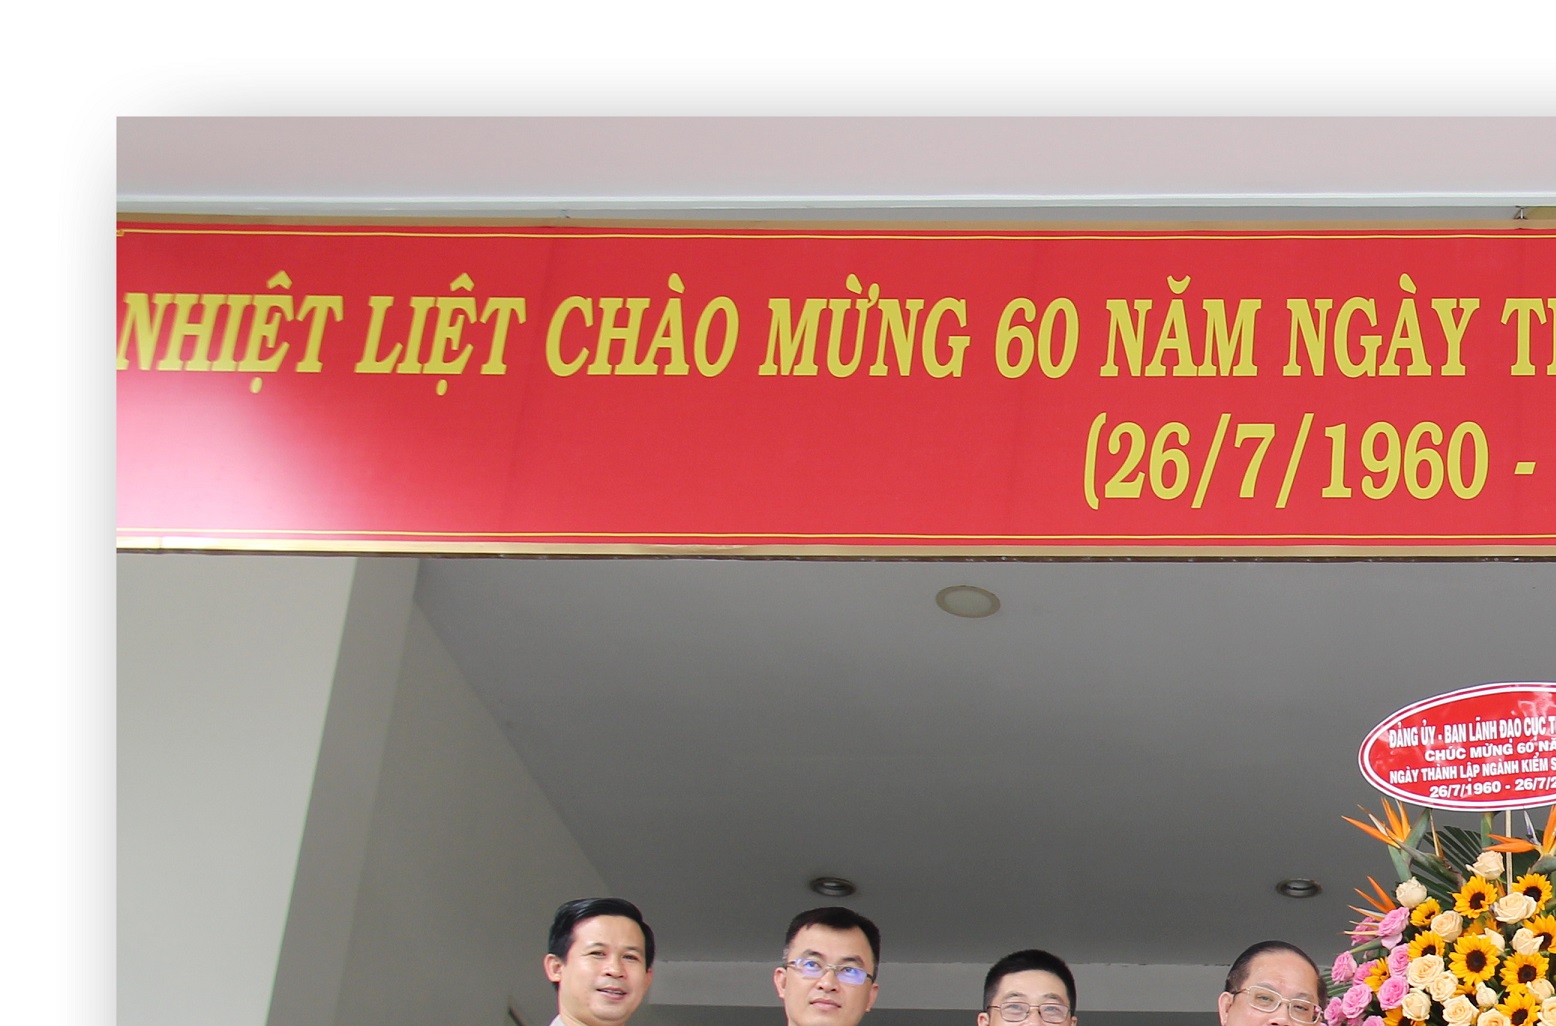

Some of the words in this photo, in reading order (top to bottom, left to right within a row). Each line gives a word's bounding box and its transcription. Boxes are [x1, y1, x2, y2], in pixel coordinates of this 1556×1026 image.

[116, 271, 343, 394] NHIỆT
[354, 273, 526, 396] LIỆT
[545, 273, 739, 377] CHÀO
[758, 273, 971, 379] MỪNG
[994, 297, 1079, 379] 60
[1099, 275, 1262, 377] NĂM
[1282, 273, 1480, 378] NGÀY
[1083, 412, 1489, 510] (26/7/1960
[1514, 461, 1536, 475] -
[1388, 721, 1419, 748] ĐẢNG
[1420, 719, 1436, 746] ỦY
[1444, 723, 1467, 744] BAN
[1468, 717, 1498, 742] LÃNH
[1499, 718, 1522, 743] ĐẠO
[1524, 716, 1547, 741] CỤC
[1389, 766, 1419, 784] NGÀY
[1421, 764, 1458, 781] THÀNH
[1459, 761, 1480, 782] LẬP
[1482, 758, 1519, 777] NGÀNH
[1521, 752, 1549, 773] KIỂM
[1424, 745, 1467, 762] CHÚC
[1469, 743, 1514, 759] MỪNG
[1517, 742, 1535, 753] 60
[1429, 780, 1501, 798] 26/7/1960
